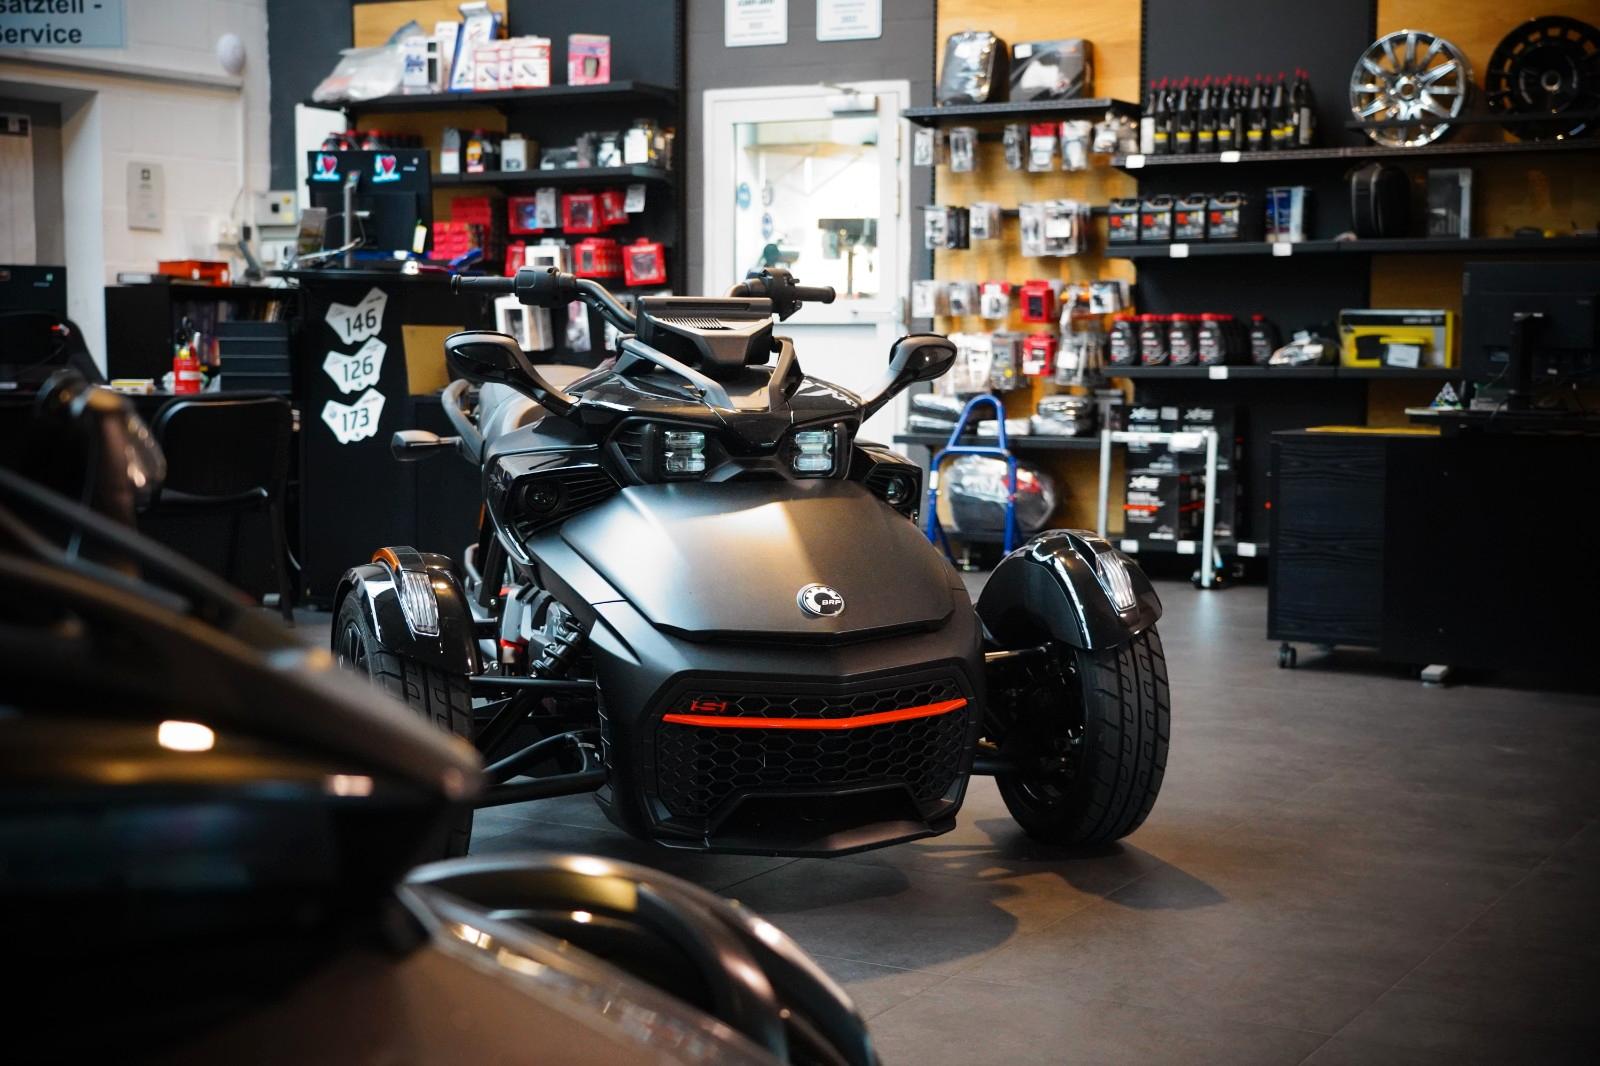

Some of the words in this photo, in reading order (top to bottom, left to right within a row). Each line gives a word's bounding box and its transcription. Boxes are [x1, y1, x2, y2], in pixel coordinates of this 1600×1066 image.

[0, 22, 82, 44] ervice
[346, 308, 377, 337] 146
[343, 355, 374, 382] 126
[342, 407, 369, 432] 173
